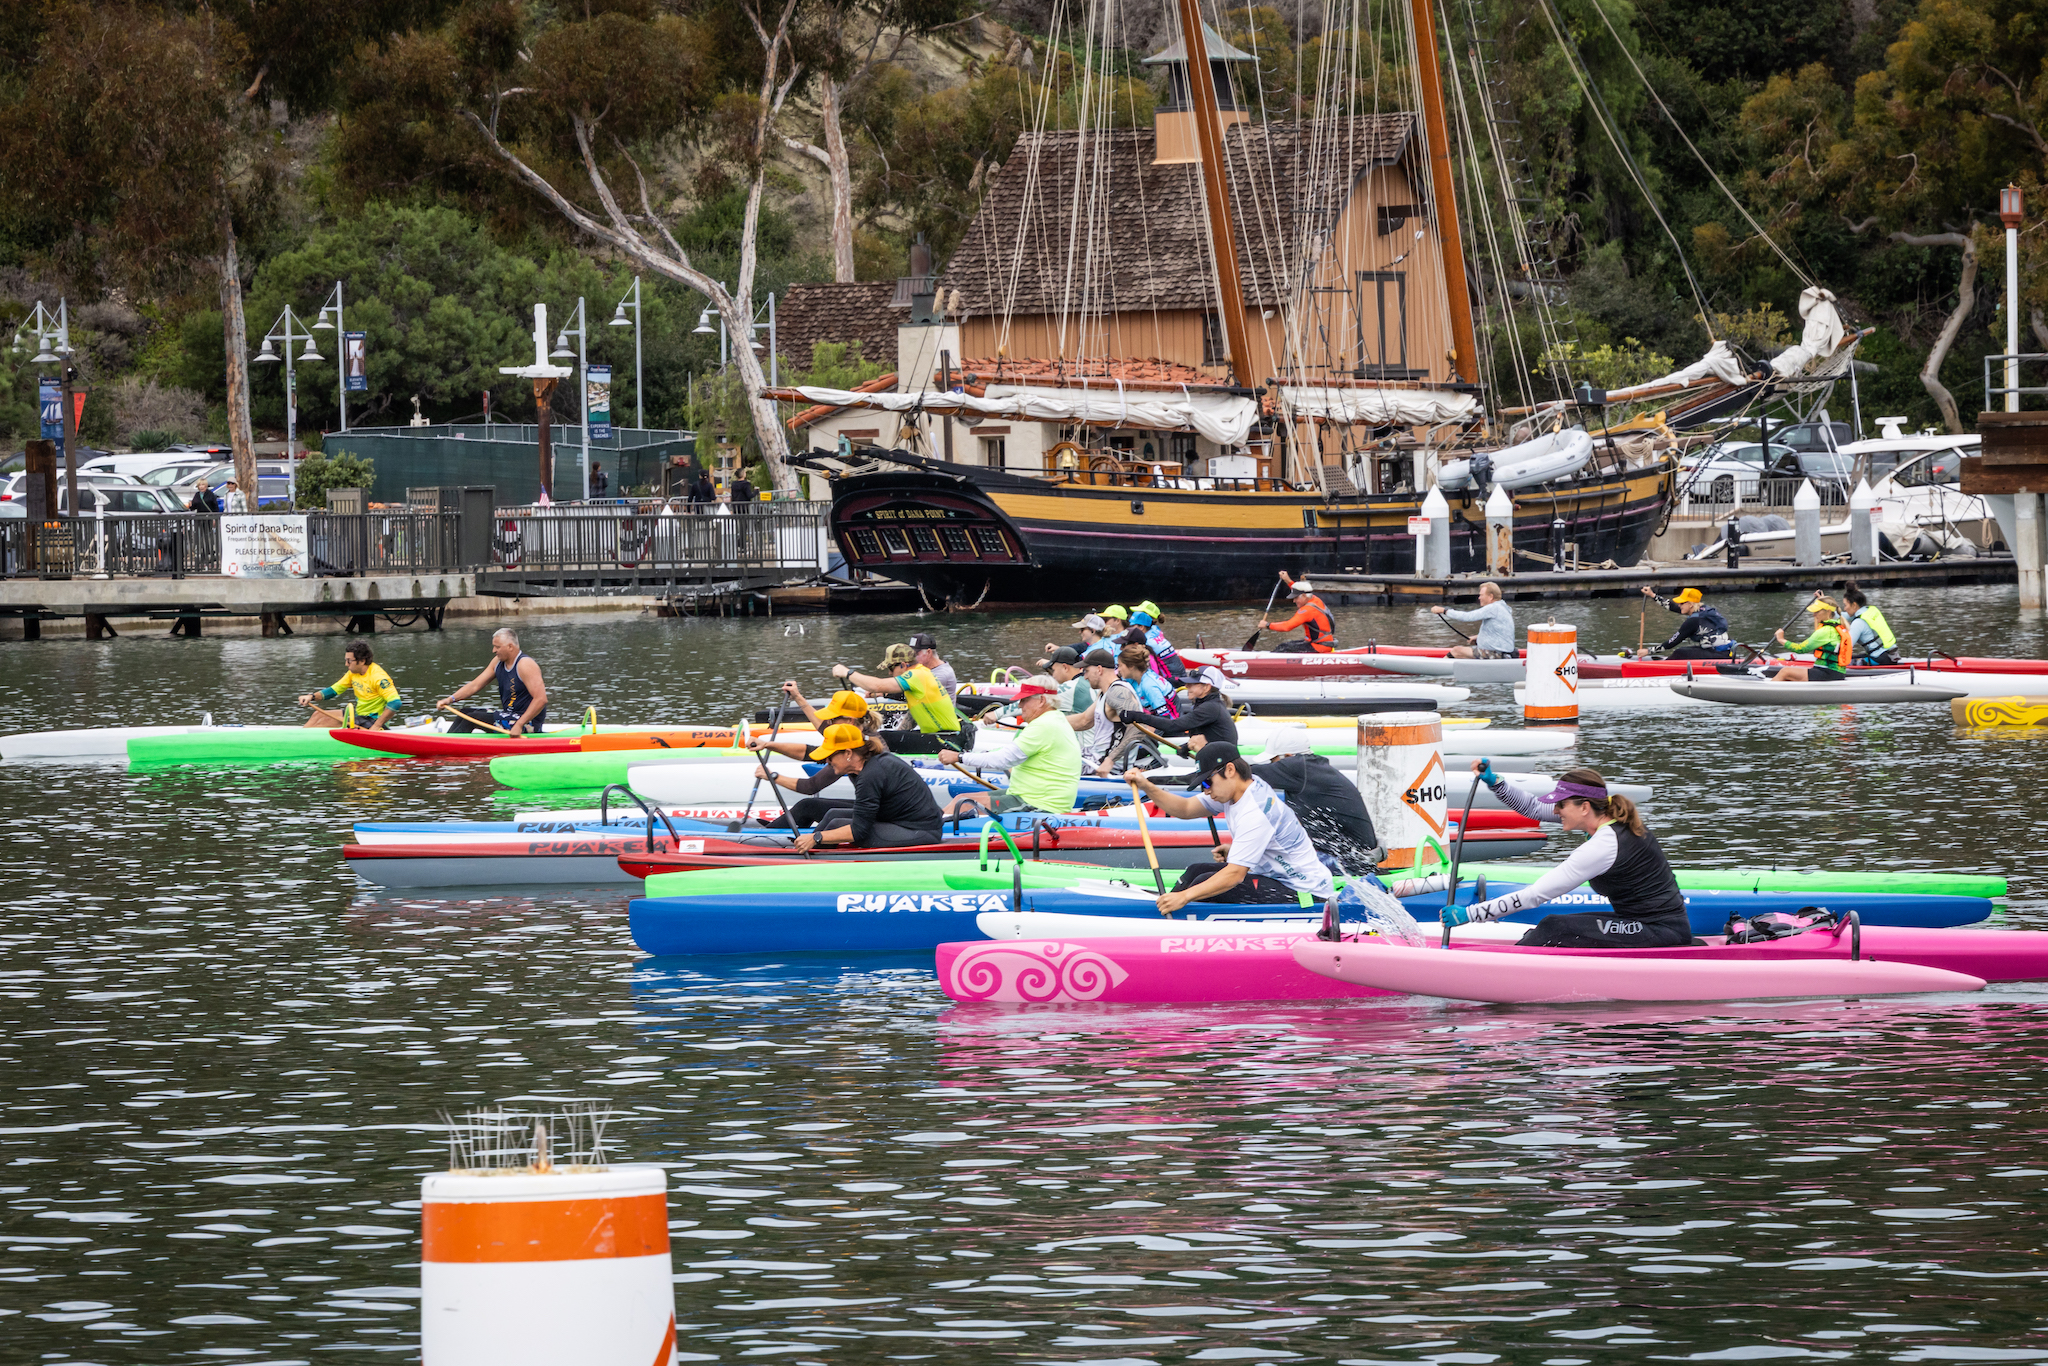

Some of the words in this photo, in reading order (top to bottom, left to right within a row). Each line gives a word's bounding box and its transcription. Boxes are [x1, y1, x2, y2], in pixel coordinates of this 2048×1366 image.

[875, 510, 897, 519] SPIRIT
[905, 510, 925, 518] DANA
[924, 509, 946, 518] POINT
[225, 523, 248, 535] Spirit
[249, 523, 258, 534] of
[259, 524, 281, 534] Dana
[282, 524, 304, 534] Point
[235, 548, 257, 556] PLEASE
[258, 548, 276, 556] KEEP
[1301, 657, 1363, 666] PUAKE
[1555, 666, 1577, 676] SHO
[672, 810, 785, 822] PUAKE
[836, 894, 1009, 913] PUAKEA
[1475, 894, 1522, 921] ROXY
